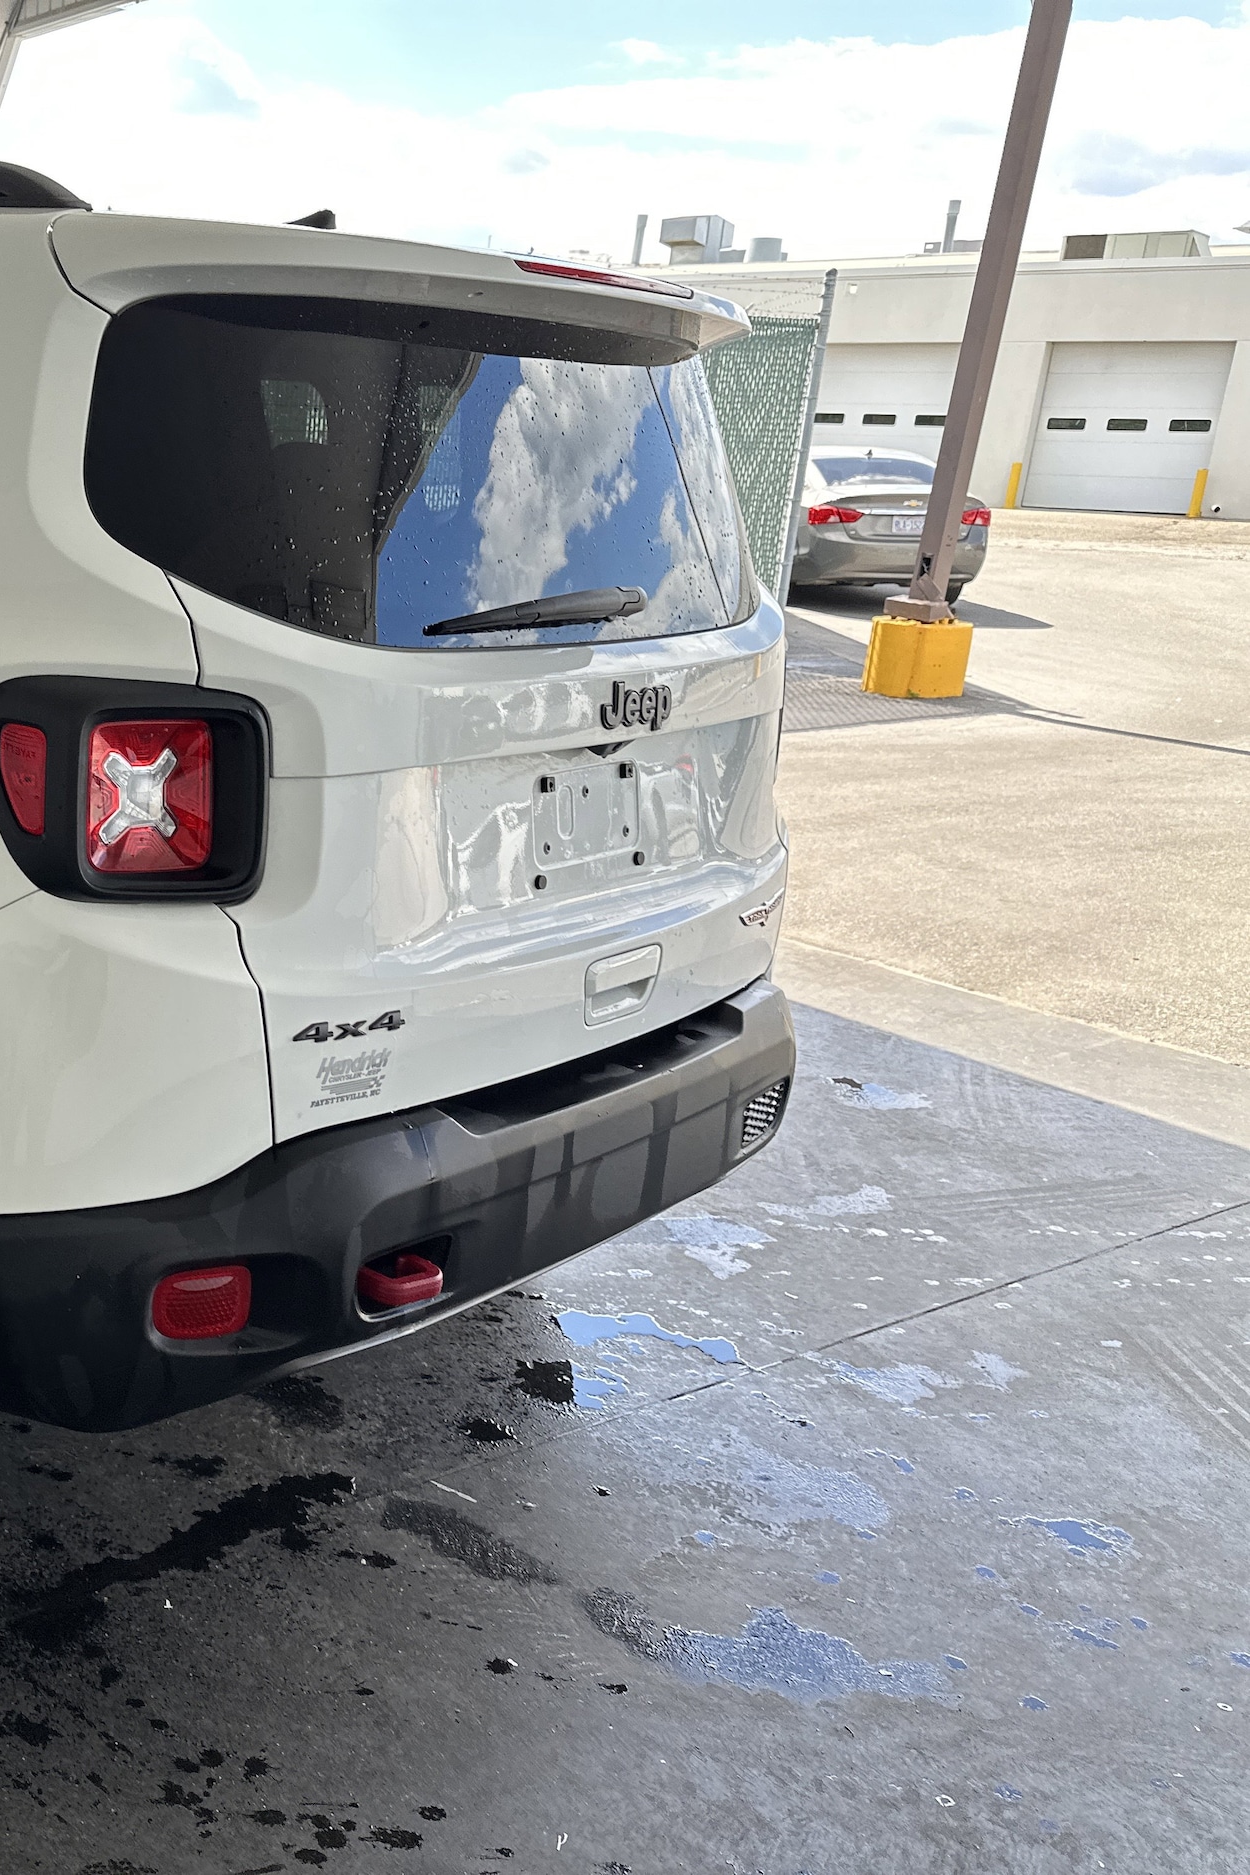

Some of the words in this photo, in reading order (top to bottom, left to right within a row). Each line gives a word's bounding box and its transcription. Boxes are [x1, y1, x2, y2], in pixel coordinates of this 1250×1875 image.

[600, 681, 672, 731] Jeep
[316, 1048, 392, 1085] Hendrick
[310, 1091, 369, 1108] FAYETTEVILLE,
[370, 1088, 381, 1097] NC
